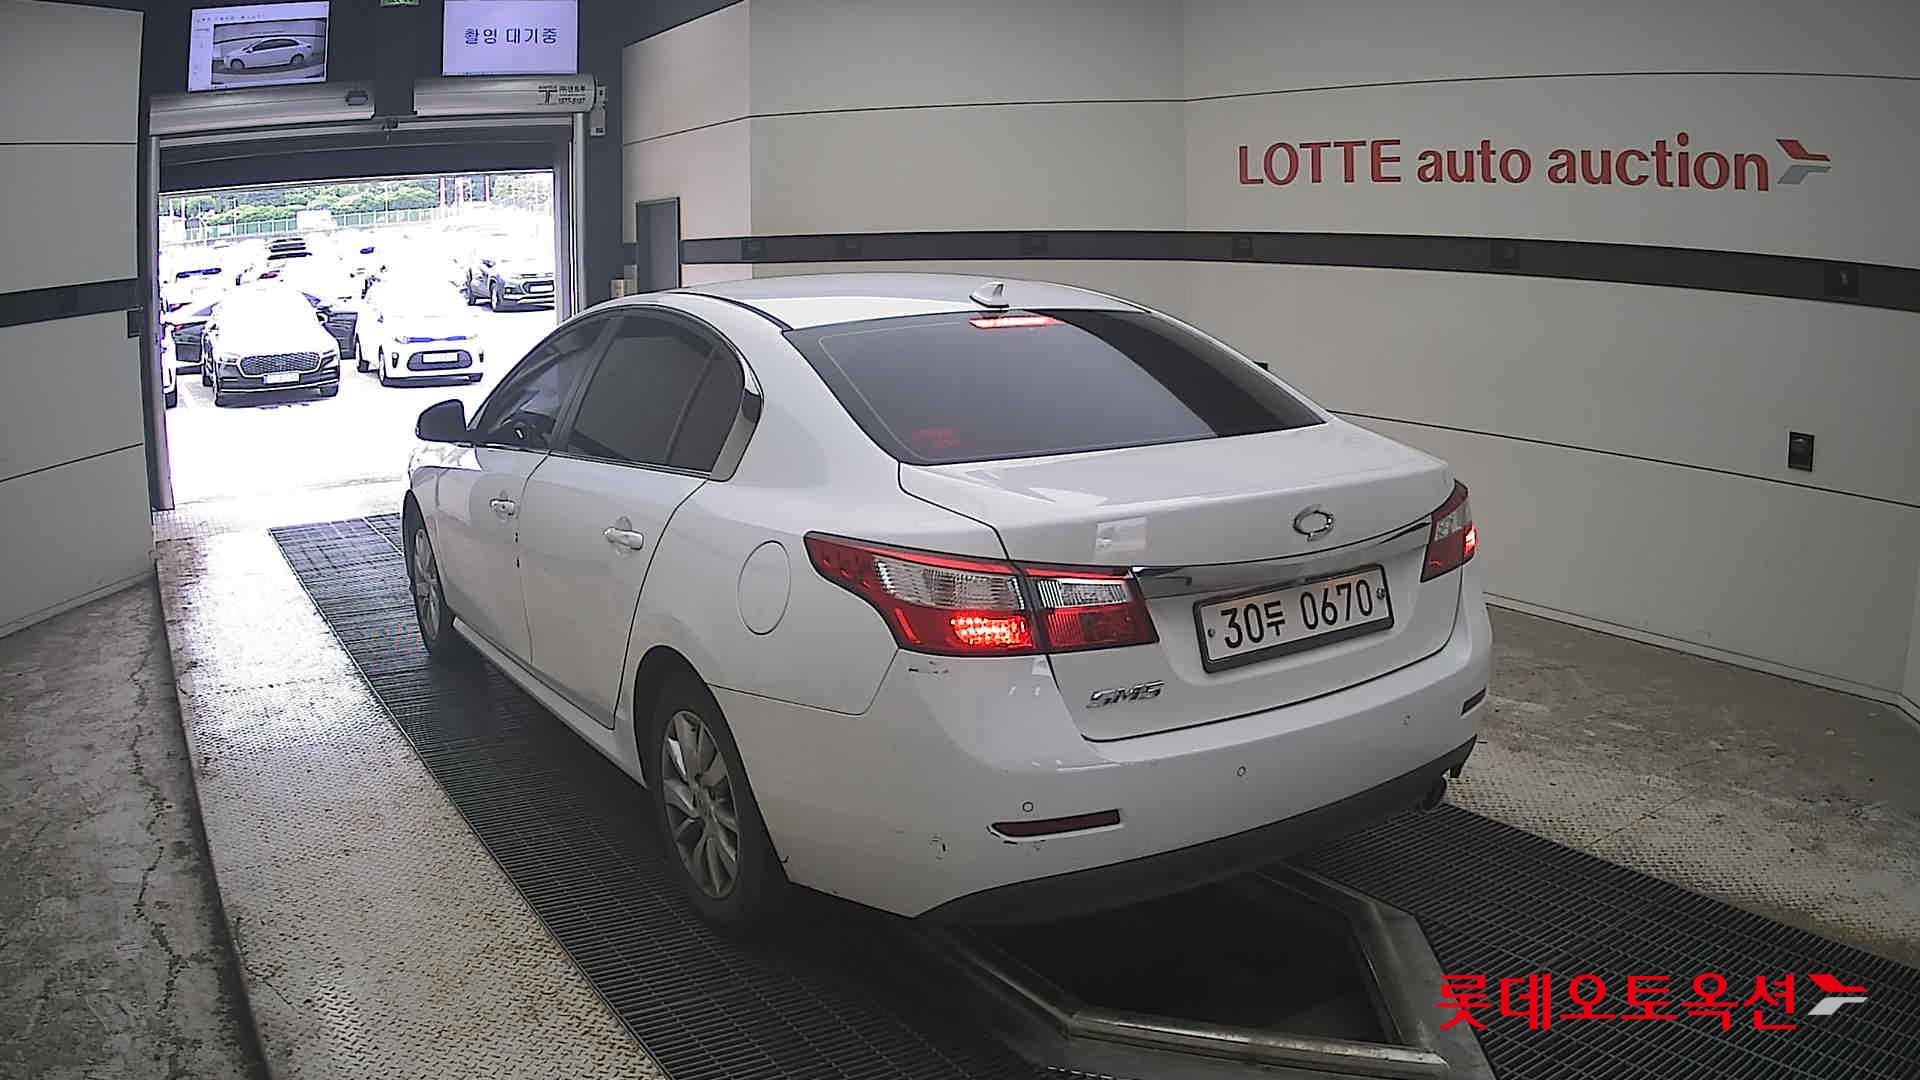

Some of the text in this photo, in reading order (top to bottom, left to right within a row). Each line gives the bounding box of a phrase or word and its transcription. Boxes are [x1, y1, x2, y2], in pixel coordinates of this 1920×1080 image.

[465, 28, 558, 45] 촬영 대기중
[1239, 132, 1769, 191] LOTTE auto auction
[1220, 579, 1373, 649] 30두 0670
[1087, 680, 1165, 708] SM5
